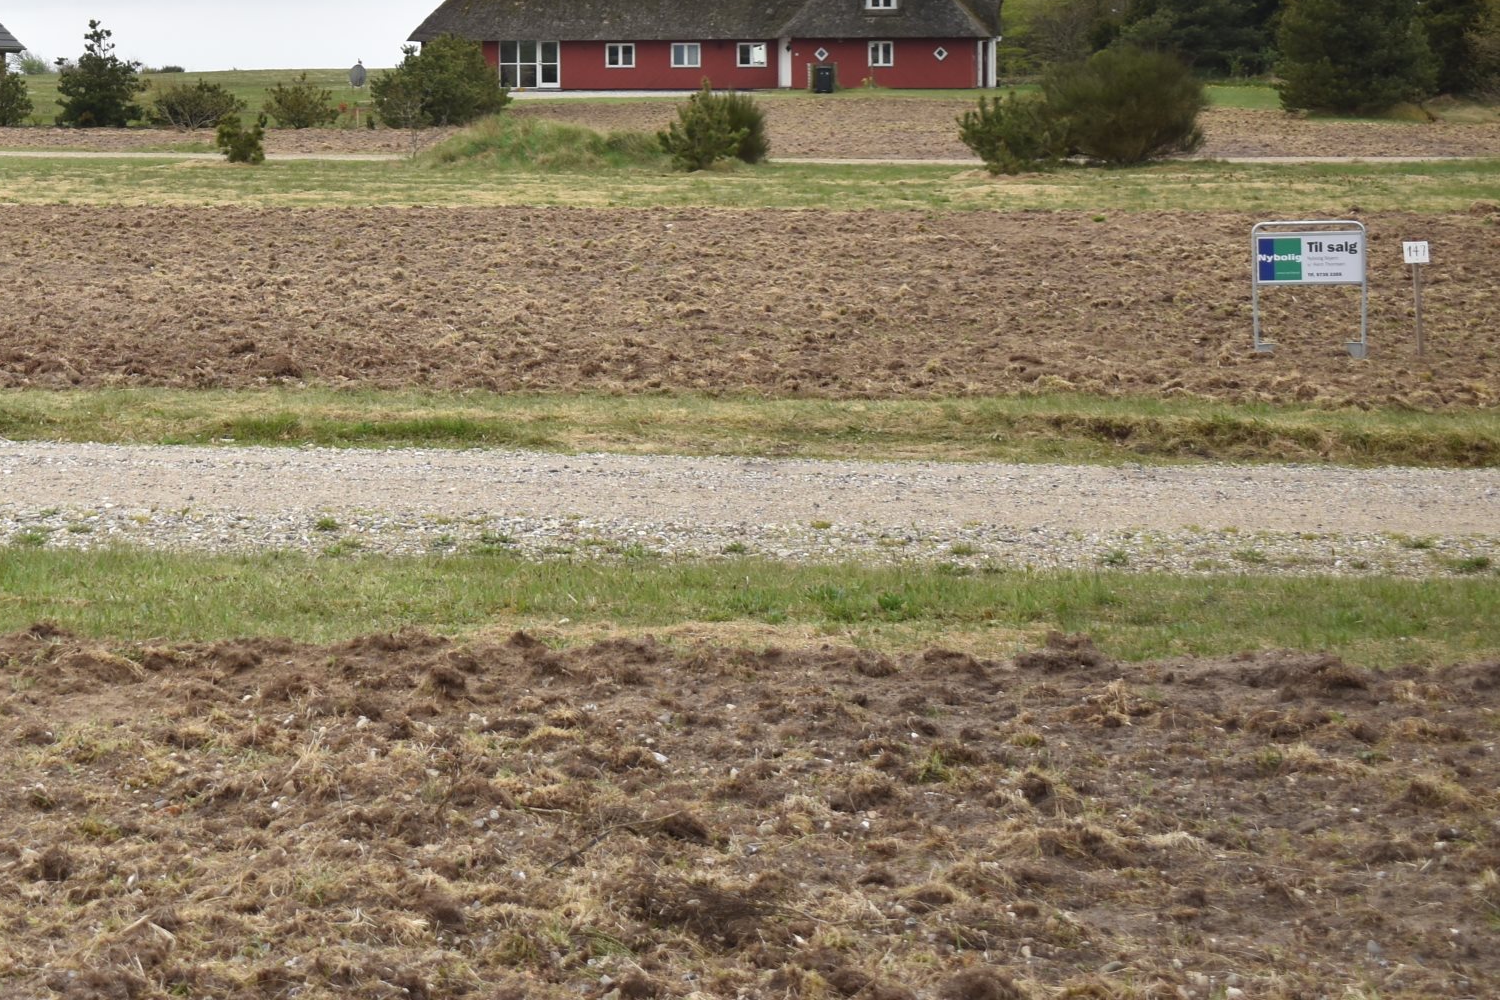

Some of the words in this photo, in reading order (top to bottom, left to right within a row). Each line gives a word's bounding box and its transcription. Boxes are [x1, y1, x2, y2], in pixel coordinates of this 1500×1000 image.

[1307, 241, 1323, 253] Til
[1327, 241, 1358, 255] salg
[1407, 244, 1426, 257] 147
[1258, 253, 1302, 263] Nybolig
